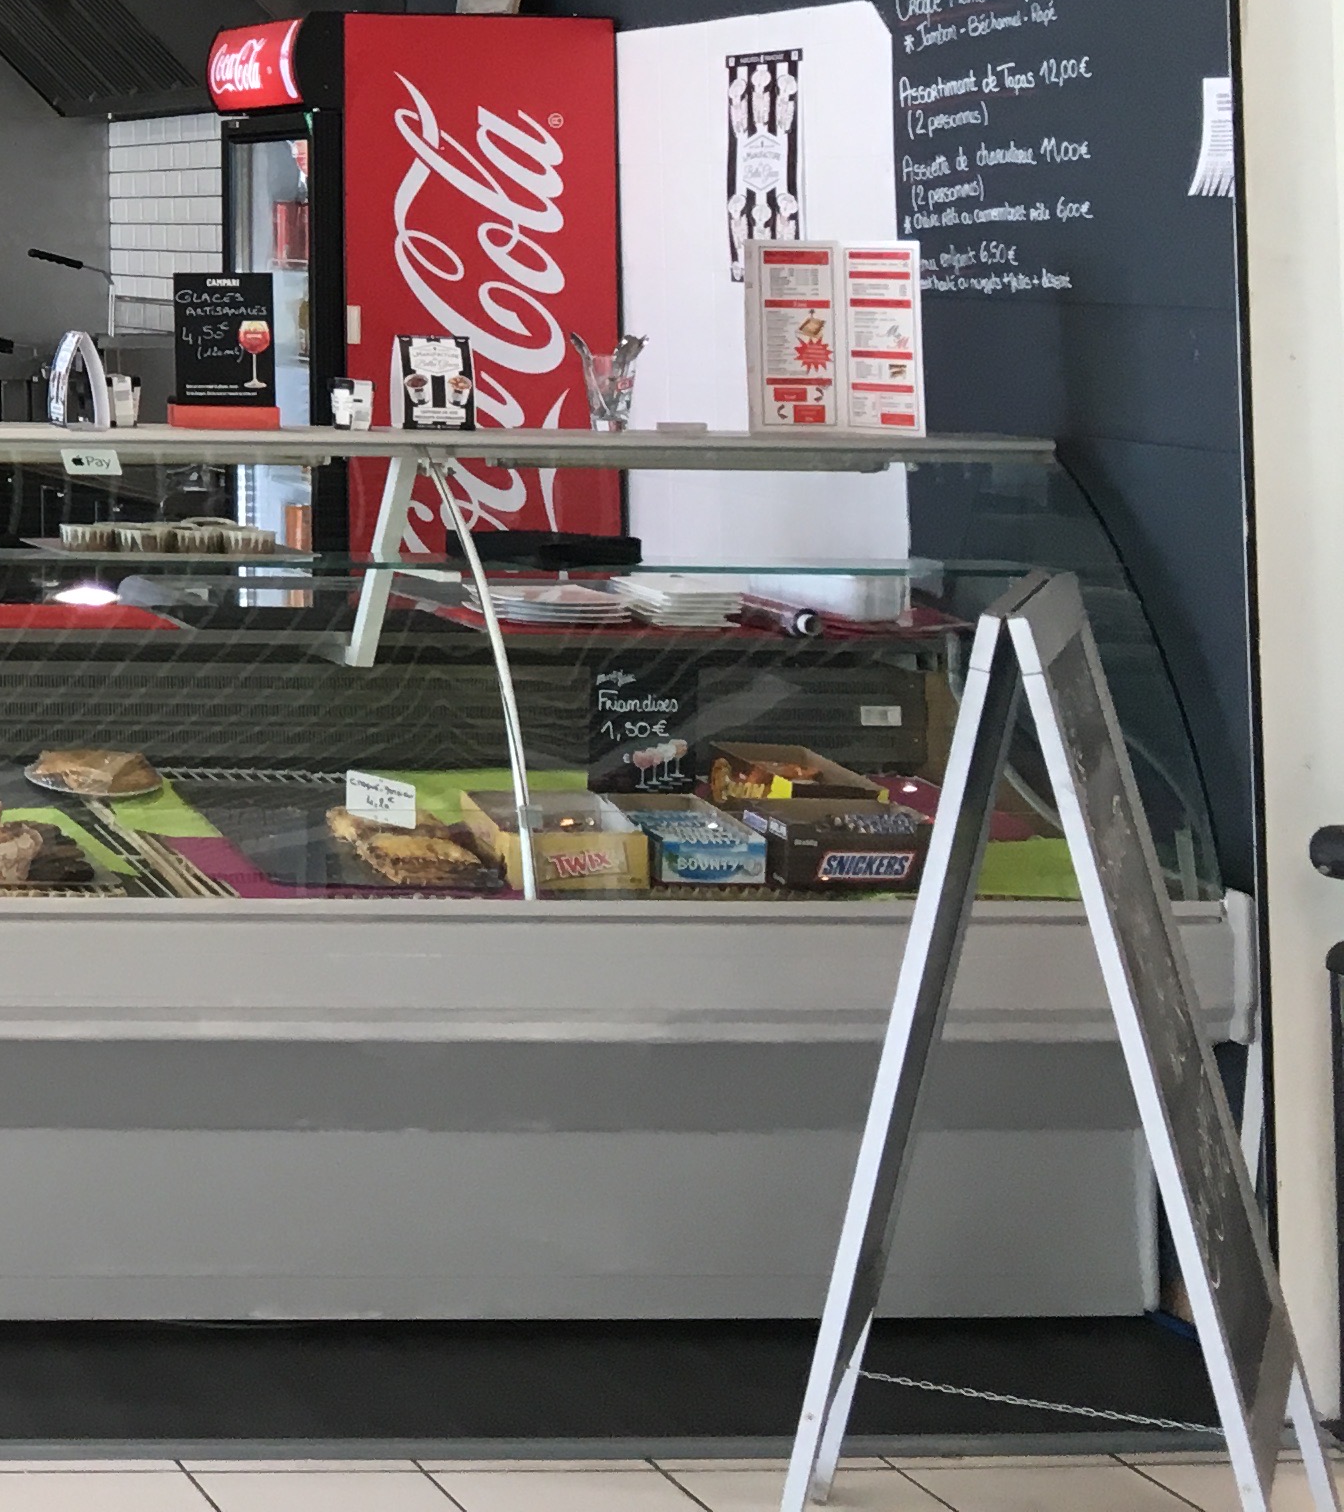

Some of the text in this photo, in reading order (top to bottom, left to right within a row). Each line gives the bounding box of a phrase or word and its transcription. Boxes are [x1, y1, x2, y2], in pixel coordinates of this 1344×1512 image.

[1039, 56, 1093, 87] 12,00€
[206, 278, 240, 287] CAMPARI
[175, 289, 245, 304] GLACES
[84, 455, 112, 469] Pay
[600, 720, 670, 742] 1,50€
[676, 856, 741, 872] BOUNTY
[821, 855, 910, 877] SNICKERS
